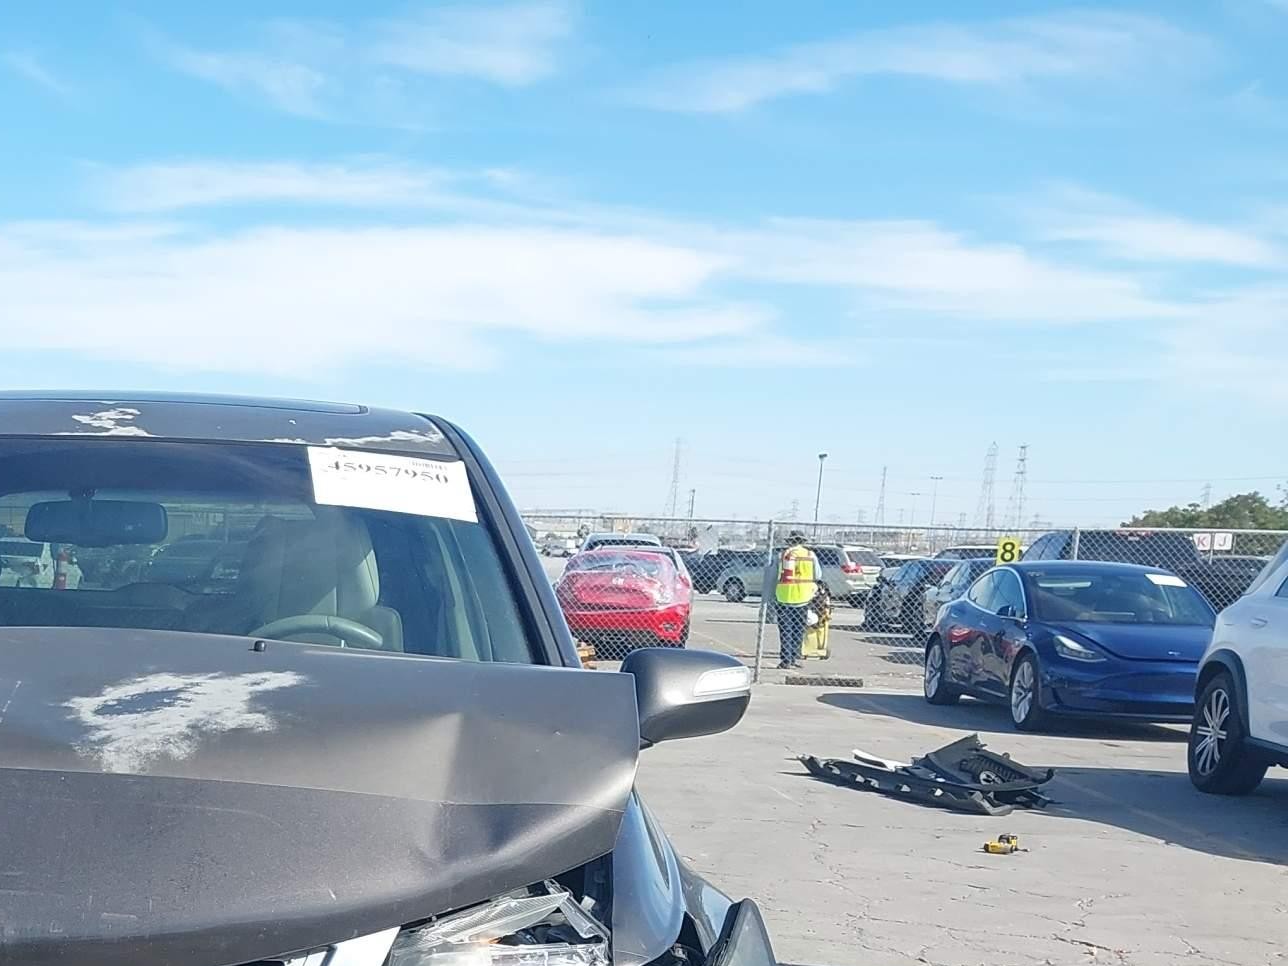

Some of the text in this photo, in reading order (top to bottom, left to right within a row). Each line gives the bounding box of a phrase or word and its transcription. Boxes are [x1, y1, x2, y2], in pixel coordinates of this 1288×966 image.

[1197, 536, 1207, 548] K
[1218, 536, 1227, 547] J
[1000, 541, 1016, 563] 8
